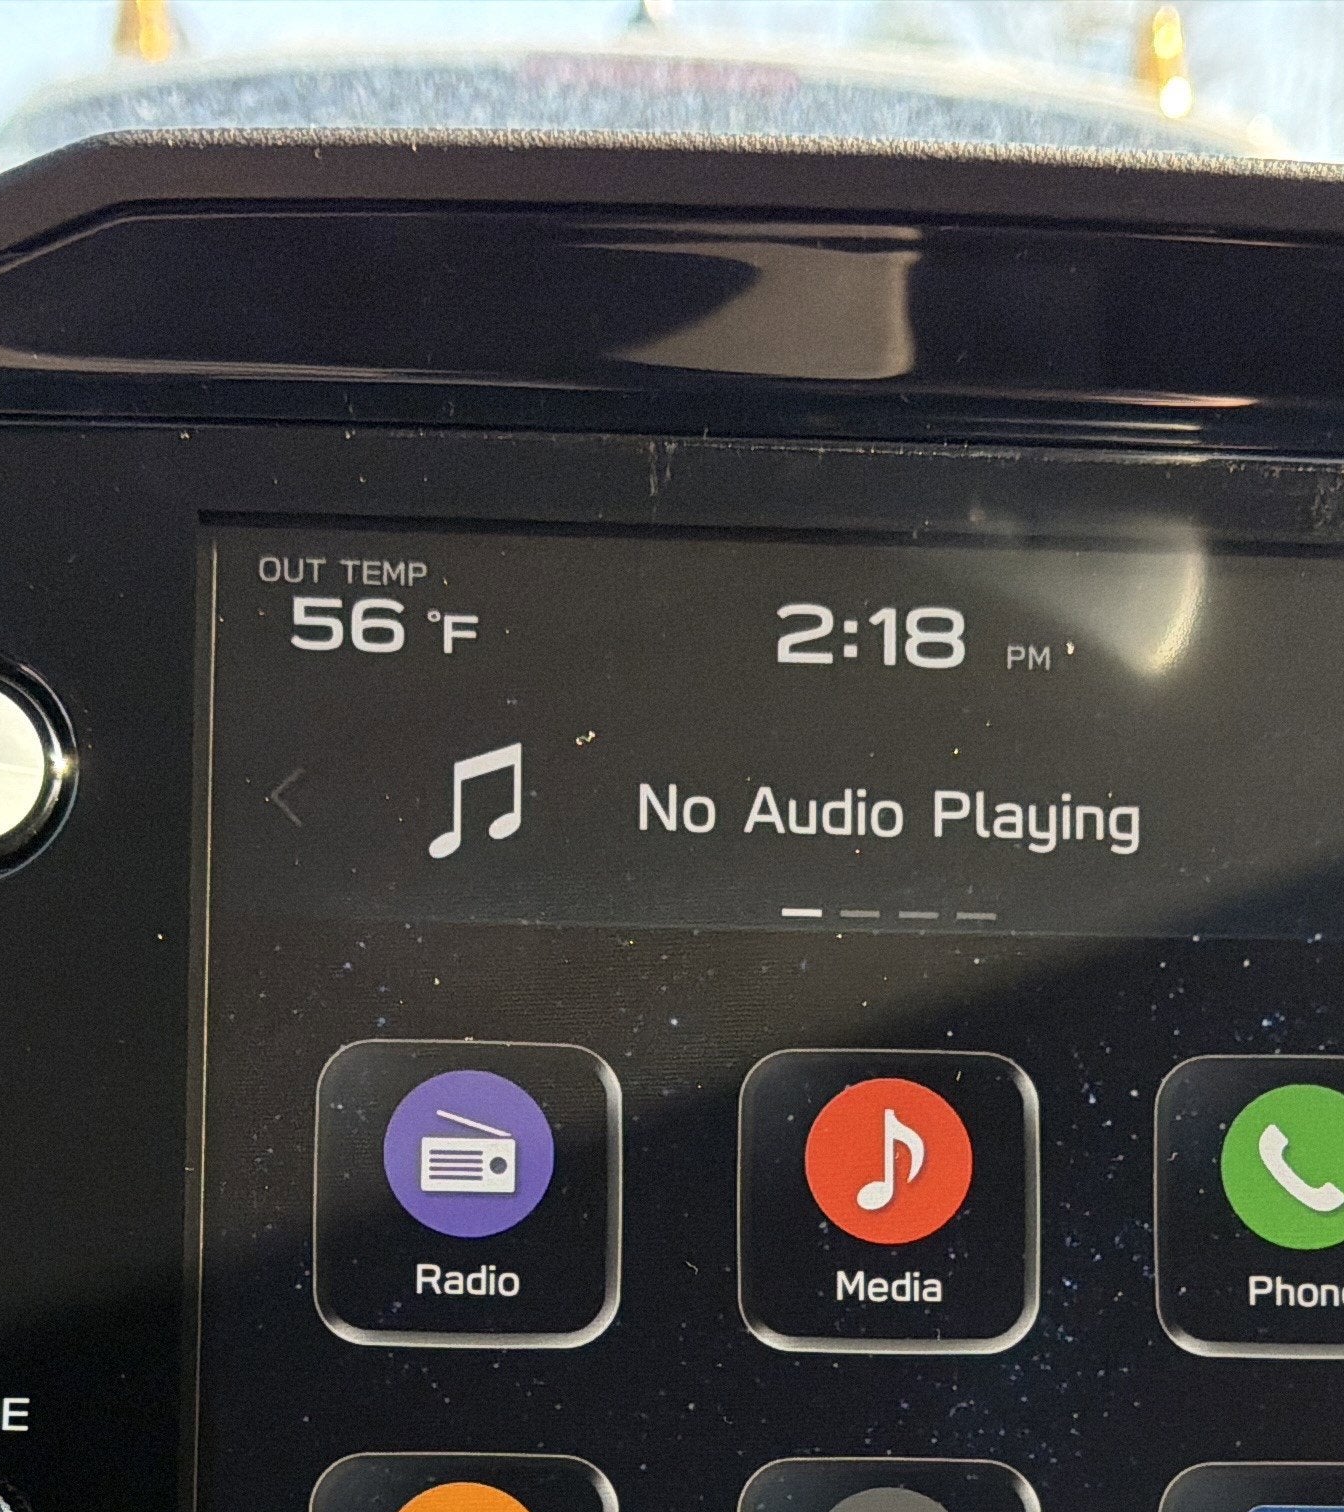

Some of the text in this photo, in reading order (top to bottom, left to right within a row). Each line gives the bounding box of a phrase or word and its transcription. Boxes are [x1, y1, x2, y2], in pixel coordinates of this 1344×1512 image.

[258, 556, 428, 587] OUT TEMP
[290, 596, 404, 653] 56
[776, 603, 1052, 671] 2:18 PM
[635, 782, 1142, 855] No Audio Playing
[415, 1264, 520, 1298] Radio
[835, 1270, 942, 1303] Media
